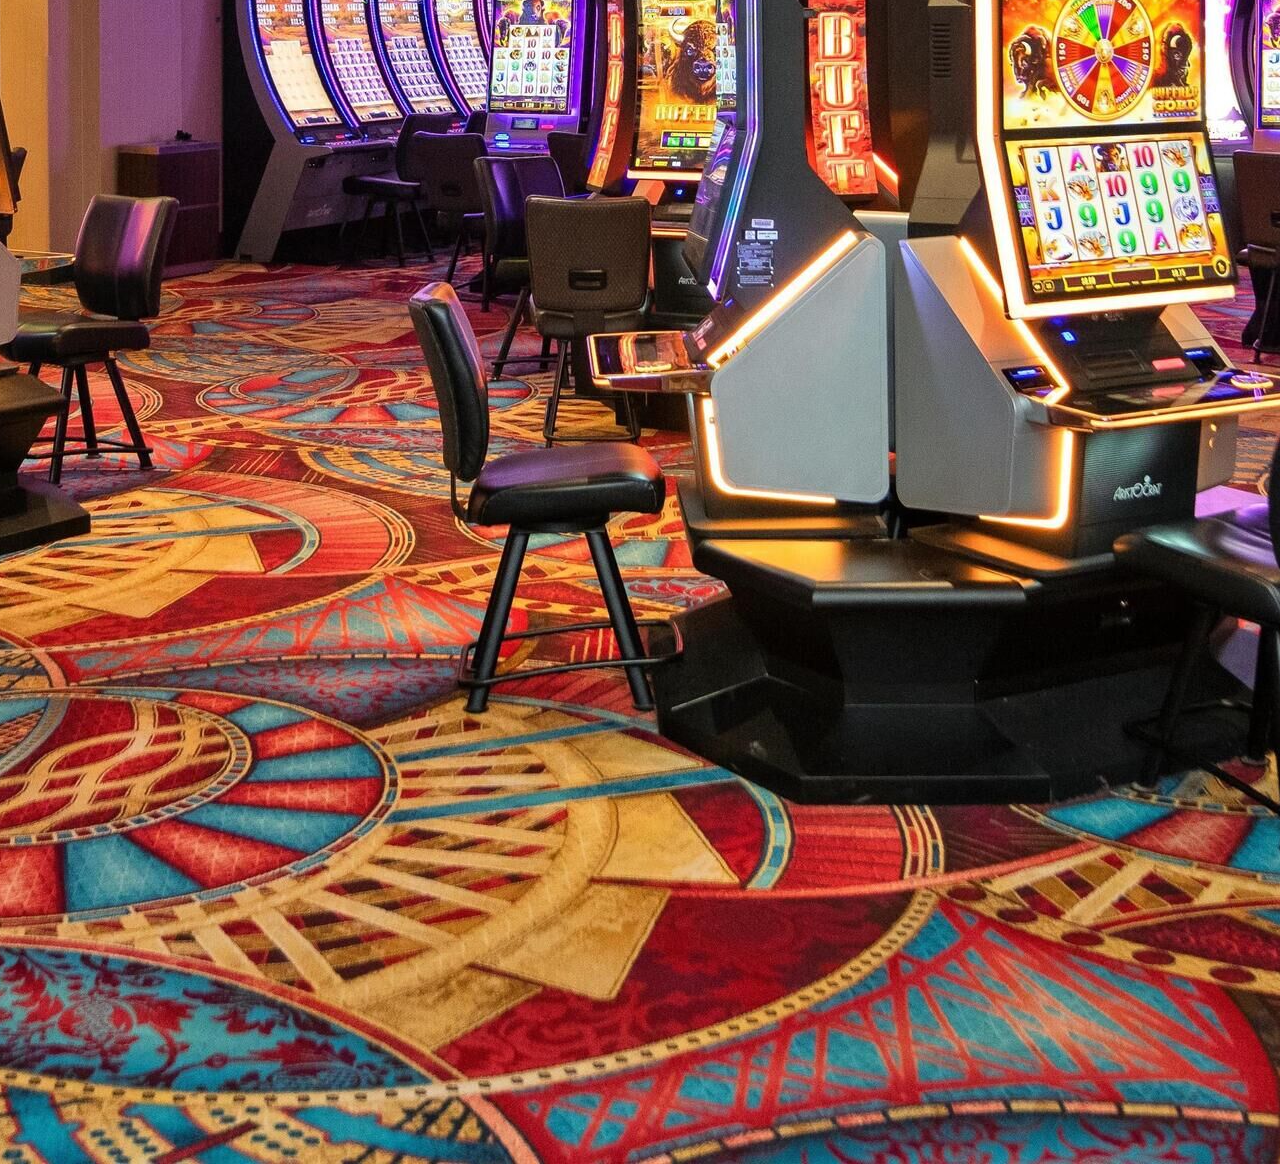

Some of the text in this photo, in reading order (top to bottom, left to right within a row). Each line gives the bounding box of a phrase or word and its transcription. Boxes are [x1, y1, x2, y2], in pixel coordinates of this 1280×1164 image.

[1133, 145, 1154, 168] 10
[1106, 174, 1127, 198] 10
[1140, 171, 1159, 196] 9
[1173, 169, 1191, 194] 9
[1079, 202, 1098, 229] 9
[1146, 199, 1164, 224] 9
[1118, 229, 1137, 253] 9
